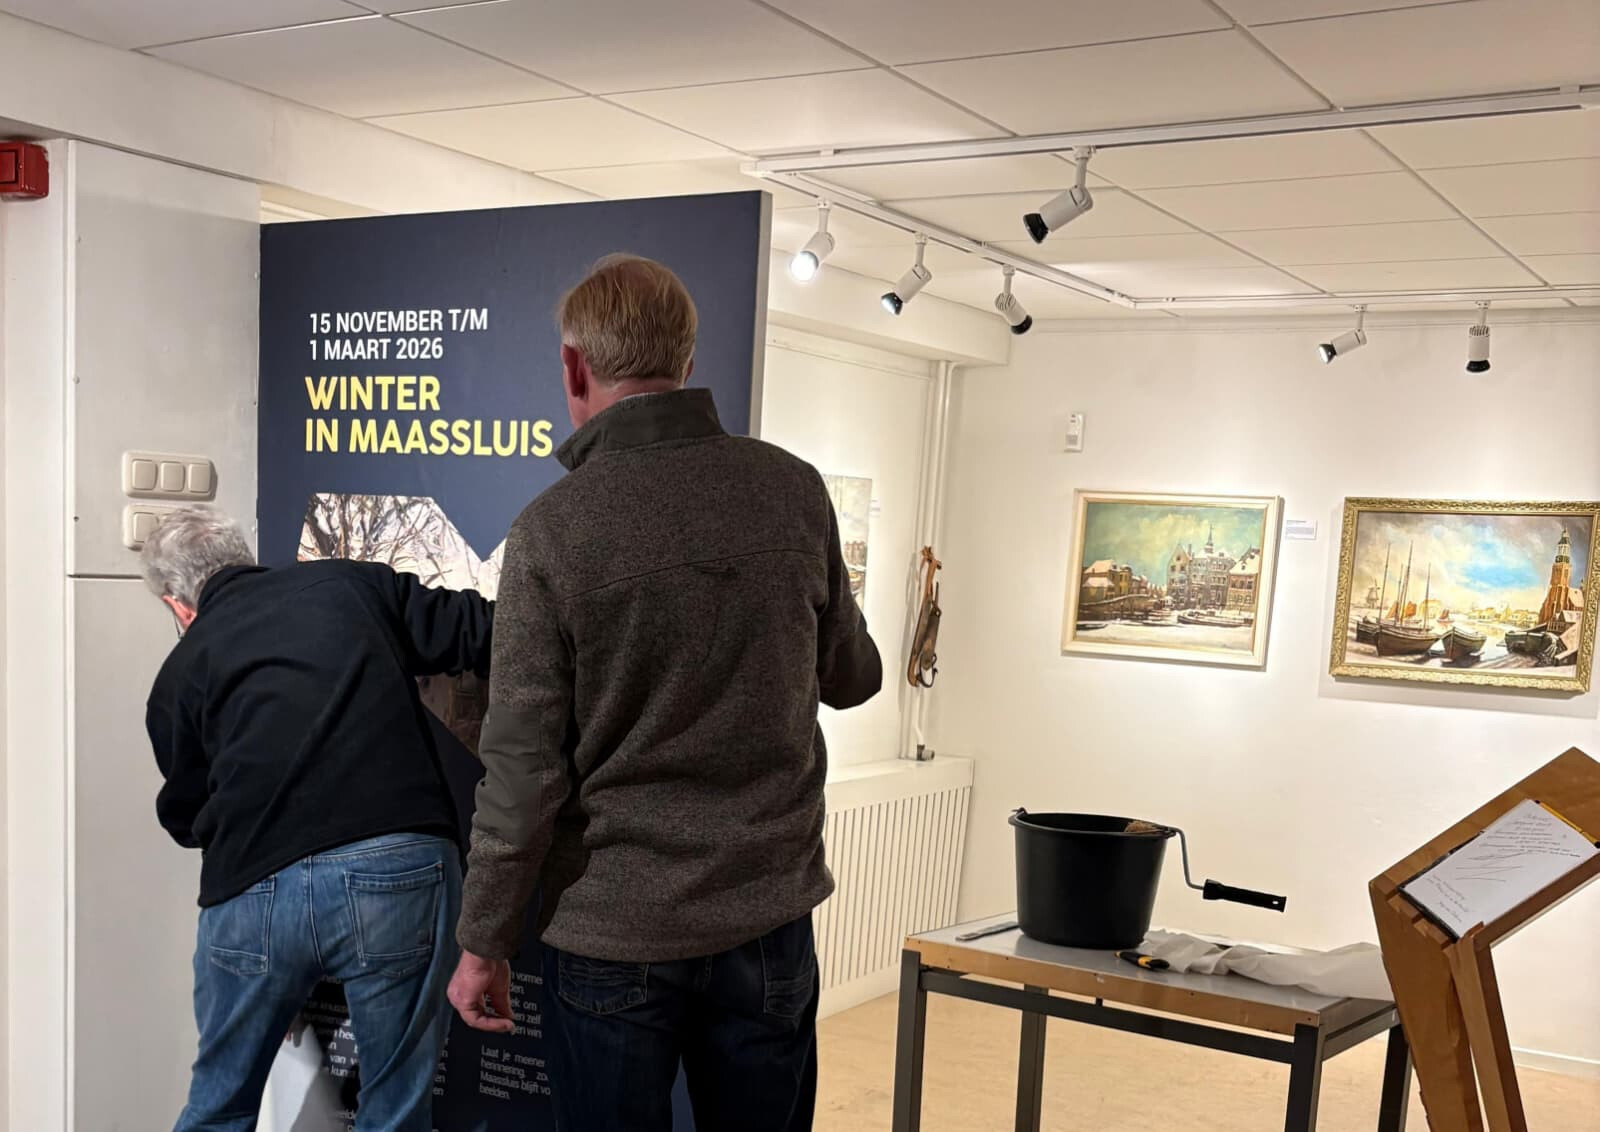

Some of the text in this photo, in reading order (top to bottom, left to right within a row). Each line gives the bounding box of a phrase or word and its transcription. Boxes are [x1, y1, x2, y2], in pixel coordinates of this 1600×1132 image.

[310, 308, 489, 334] 15 NOVEMBER T/M
[309, 337, 443, 361] 1 MAART 2026
[305, 375, 441, 411] WINTER
[305, 418, 554, 457] IN MAASSLUIS
[481, 1044, 499, 1058] Laat
